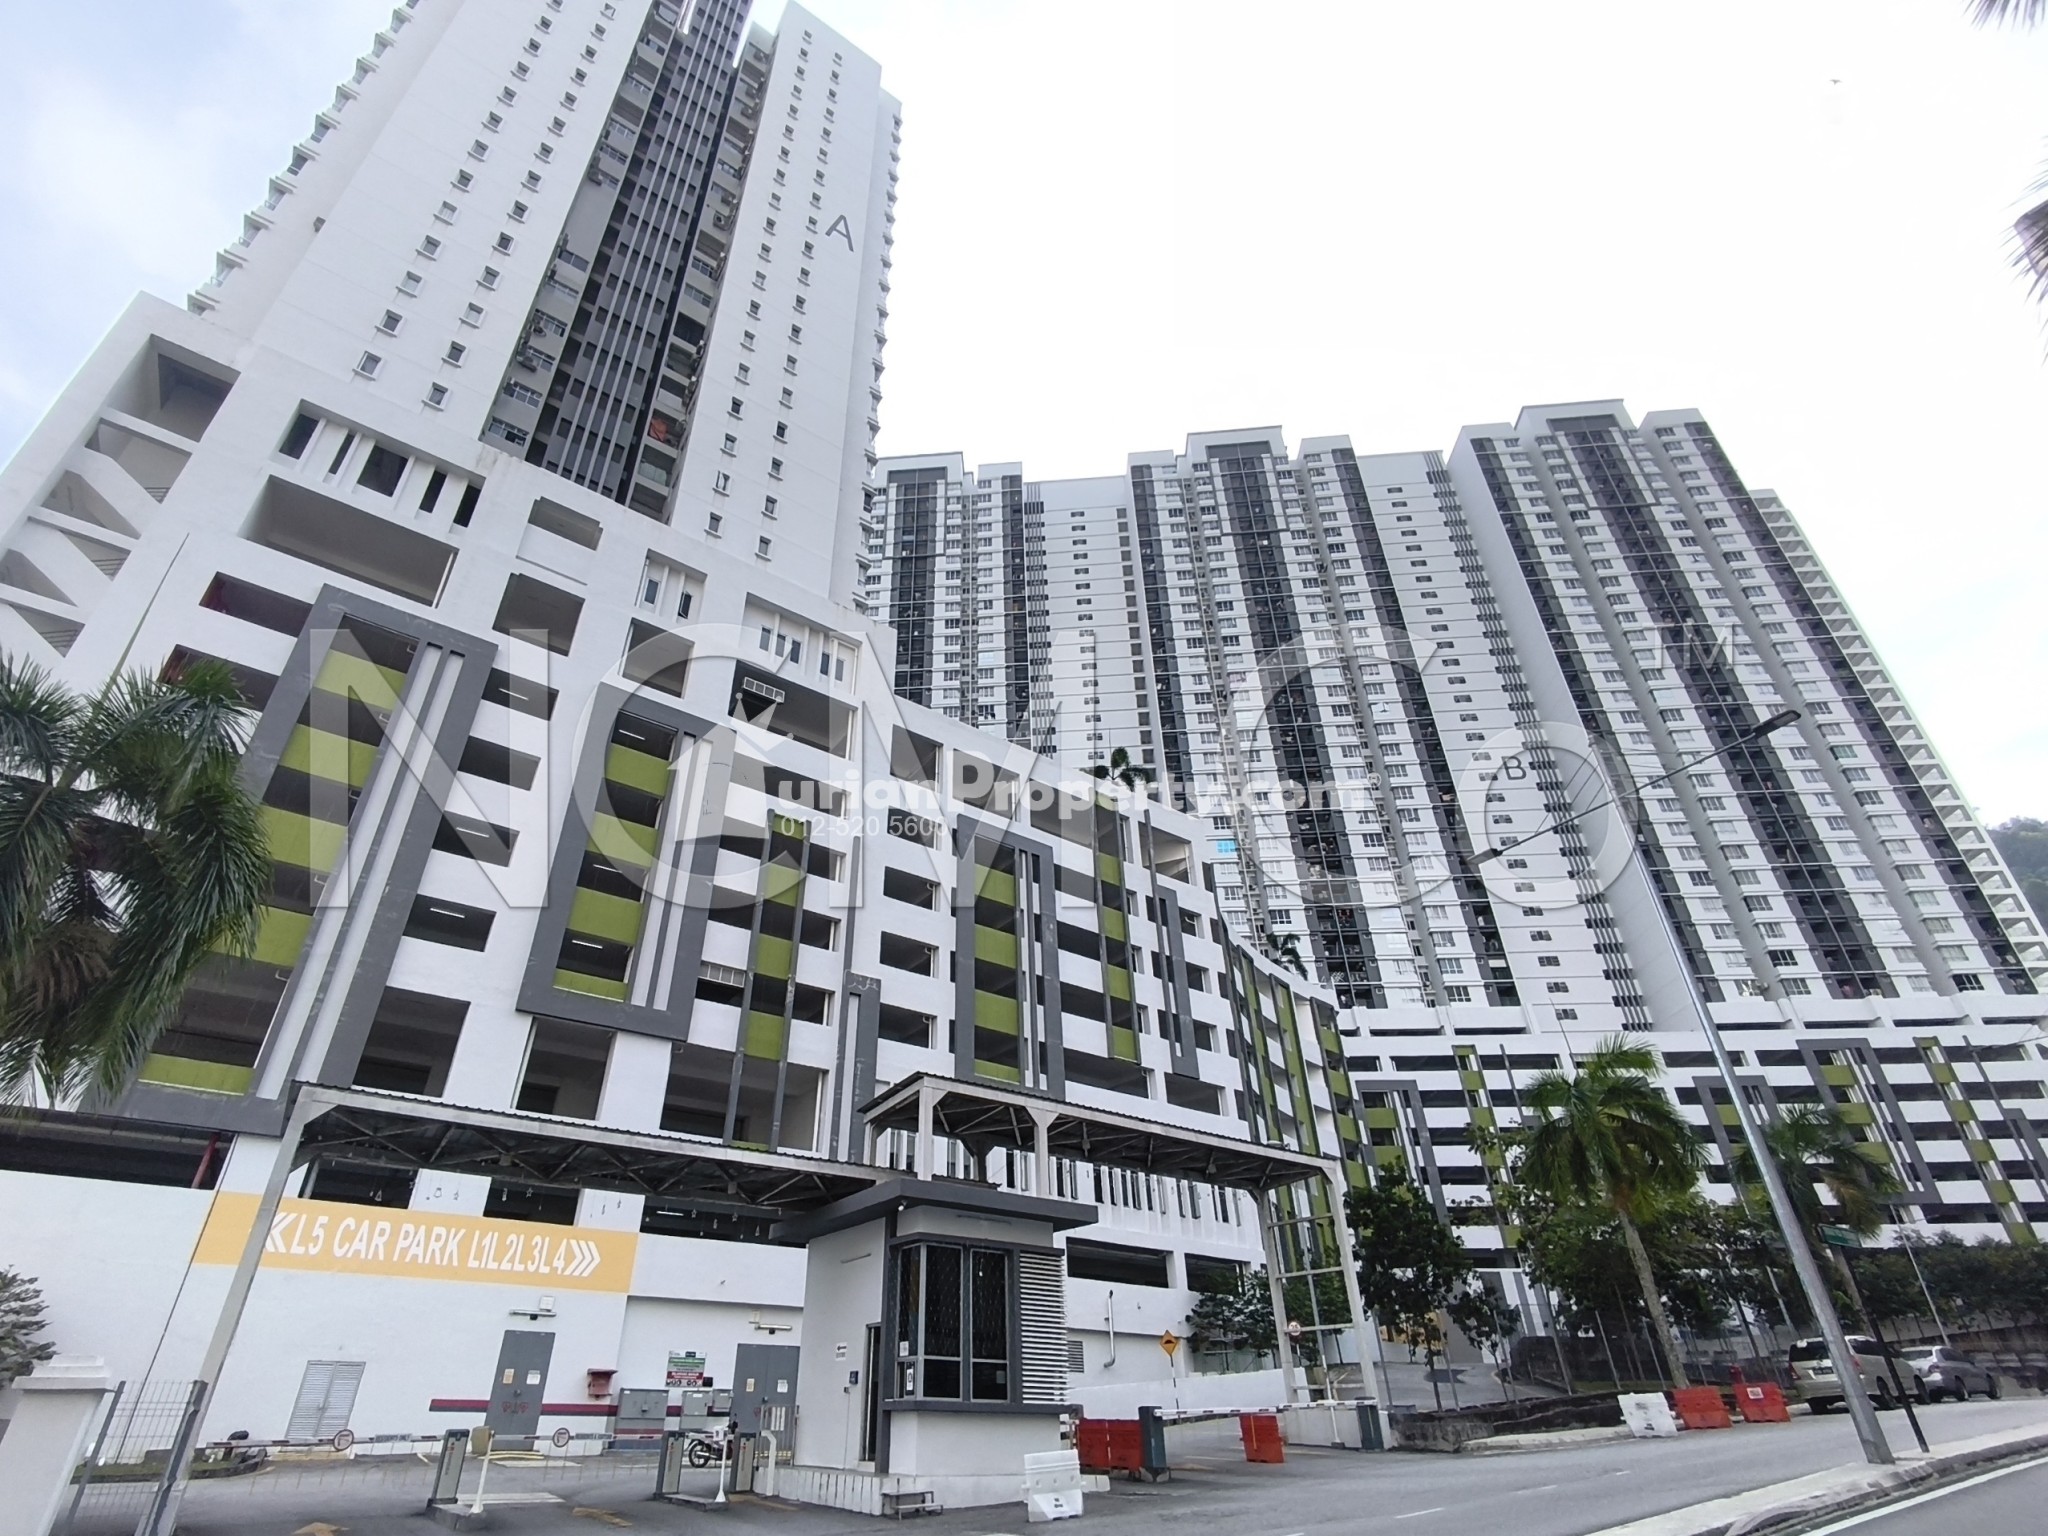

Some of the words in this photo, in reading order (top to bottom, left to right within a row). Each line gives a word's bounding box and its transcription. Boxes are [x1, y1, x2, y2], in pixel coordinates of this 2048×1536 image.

[825, 214, 854, 252] A
[1501, 755, 1527, 780] B
[333, 1216, 391, 1261] CAR
[393, 1222, 466, 1267] PARK
